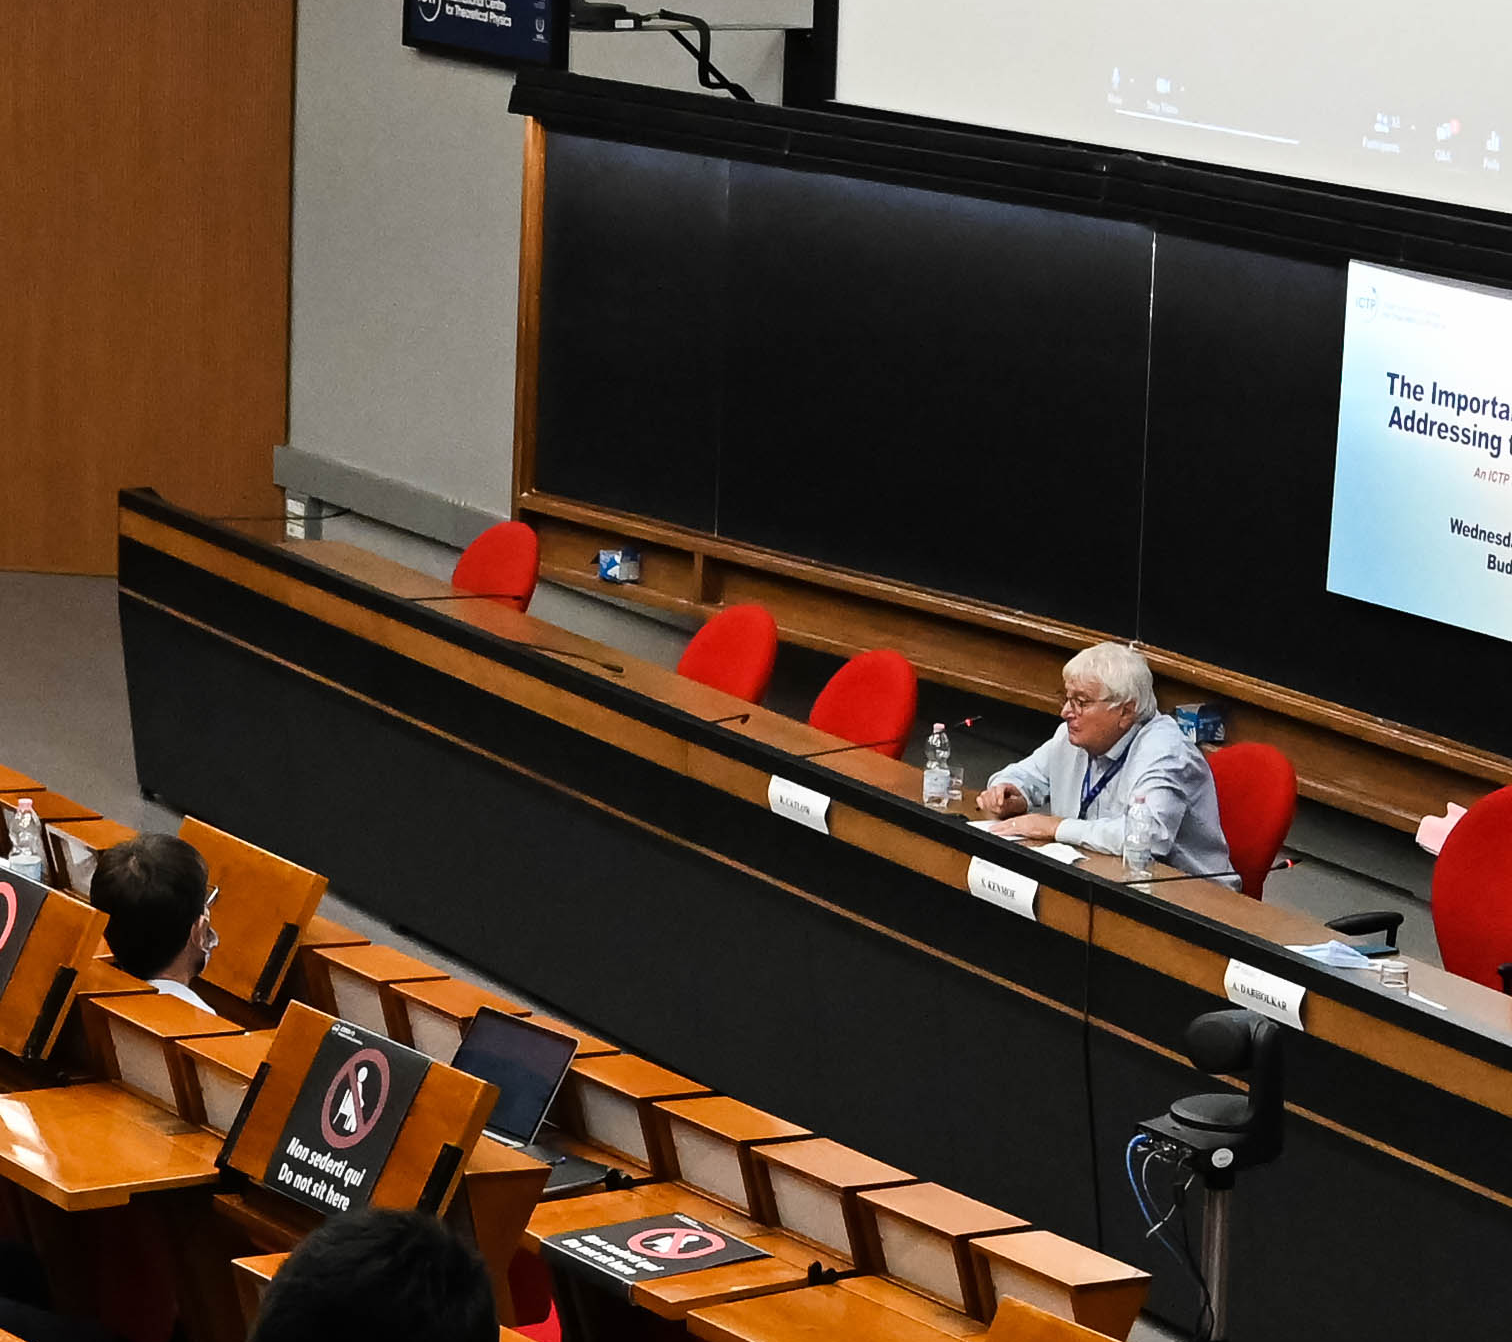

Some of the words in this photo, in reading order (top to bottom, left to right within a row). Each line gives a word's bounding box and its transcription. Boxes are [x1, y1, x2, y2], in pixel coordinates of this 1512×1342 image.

[1355, 296, 1376, 309] ICTP
[1386, 371, 1425, 402] The
[1388, 405, 1502, 459] Addressing
[1474, 466, 1487, 479] An
[1488, 469, 1510, 485] ICTP
[286, 1136, 310, 1161] Non
[308, 1151, 348, 1178] sederti
[344, 1167, 366, 1187] qui
[277, 1162, 294, 1182] Do
[292, 1170, 312, 1194] not
[310, 1180, 327, 1200] sit
[325, 1189, 350, 1211] here
